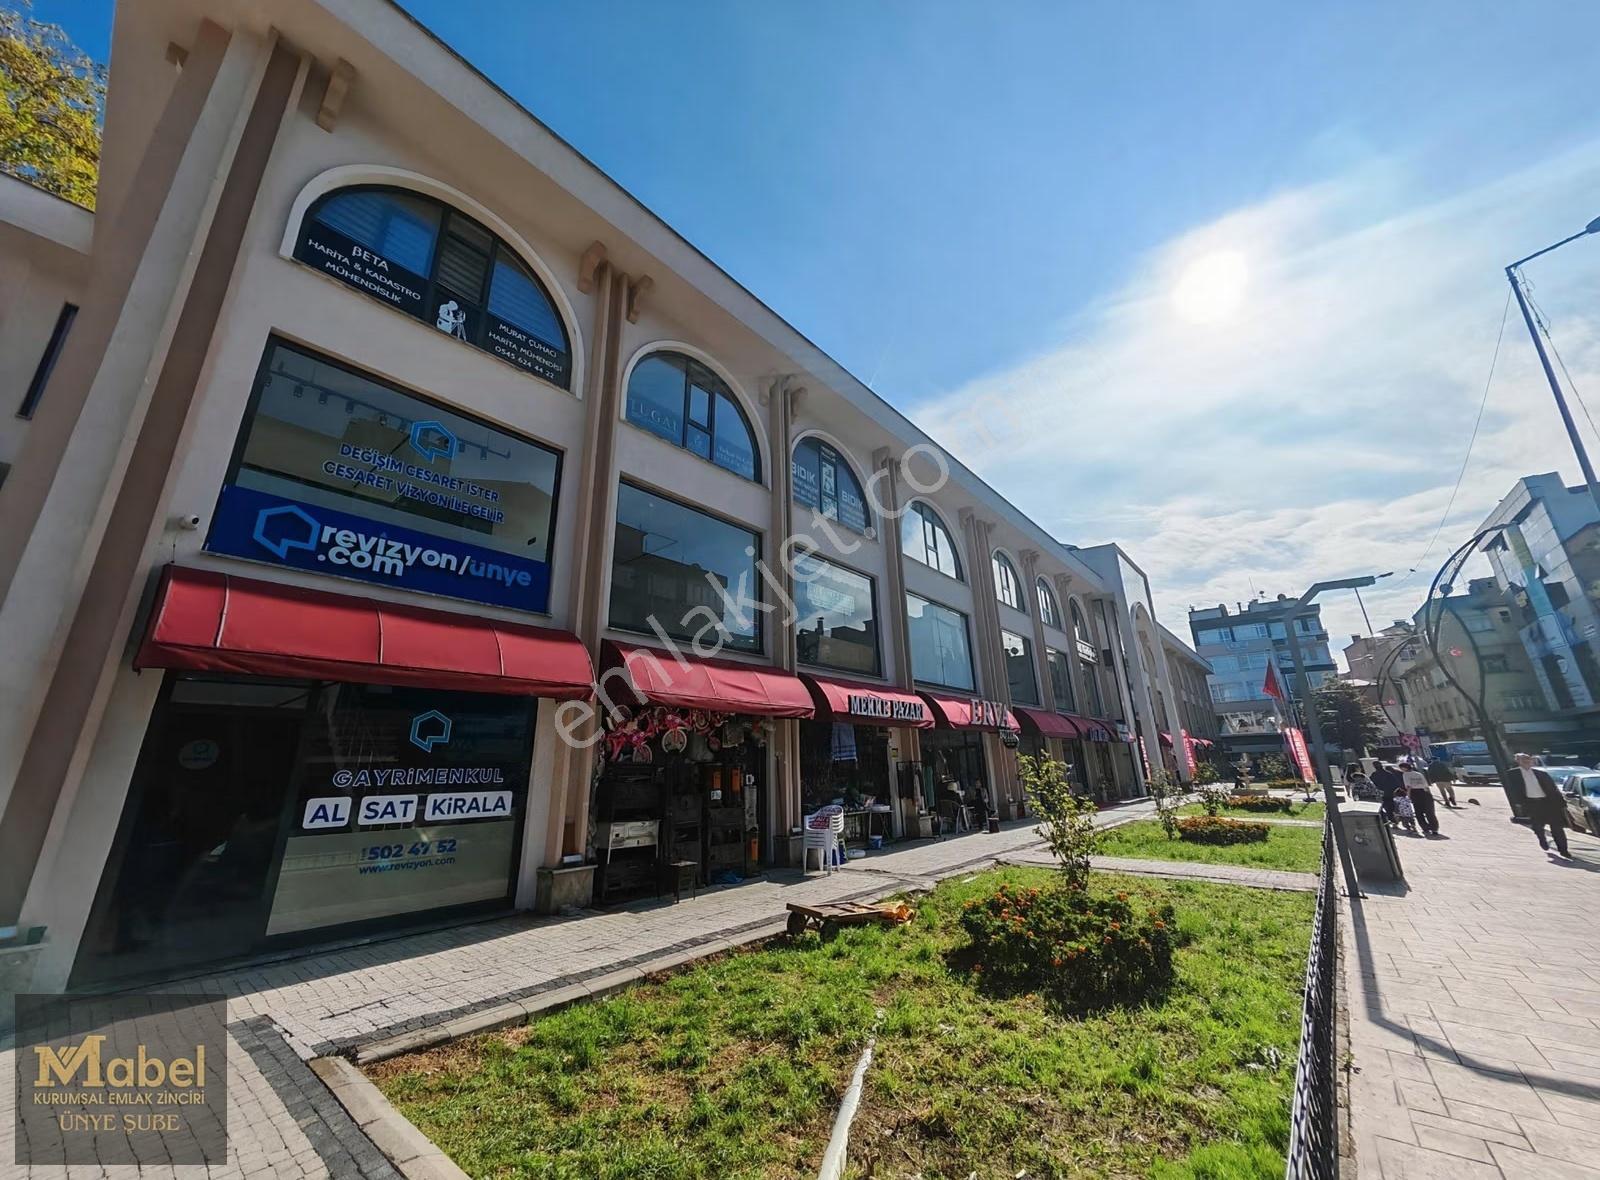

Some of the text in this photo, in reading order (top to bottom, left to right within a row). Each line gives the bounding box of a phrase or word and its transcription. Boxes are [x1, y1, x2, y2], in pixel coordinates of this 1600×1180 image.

[308, 239, 421, 300] HARİTA & KADASTRO
[325, 261, 402, 303] MÜHENDİSLİK
[488, 330, 518, 351] HARİTA
[499, 323, 527, 342] MURAT
[494, 345, 554, 379] 0545 624 44 22
[322, 460, 394, 491] CESARET
[395, 481, 451, 508] VİZYON
[339, 443, 499, 503] DEĞİŞİM CESARET İSTER
[317, 547, 405, 577] .com
[970, 698, 1010, 728] ERVA
[309, 803, 346, 824] AL
[363, 800, 415, 820] SAT
[367, 843, 404, 861] 502
[436, 838, 457, 853] 52
